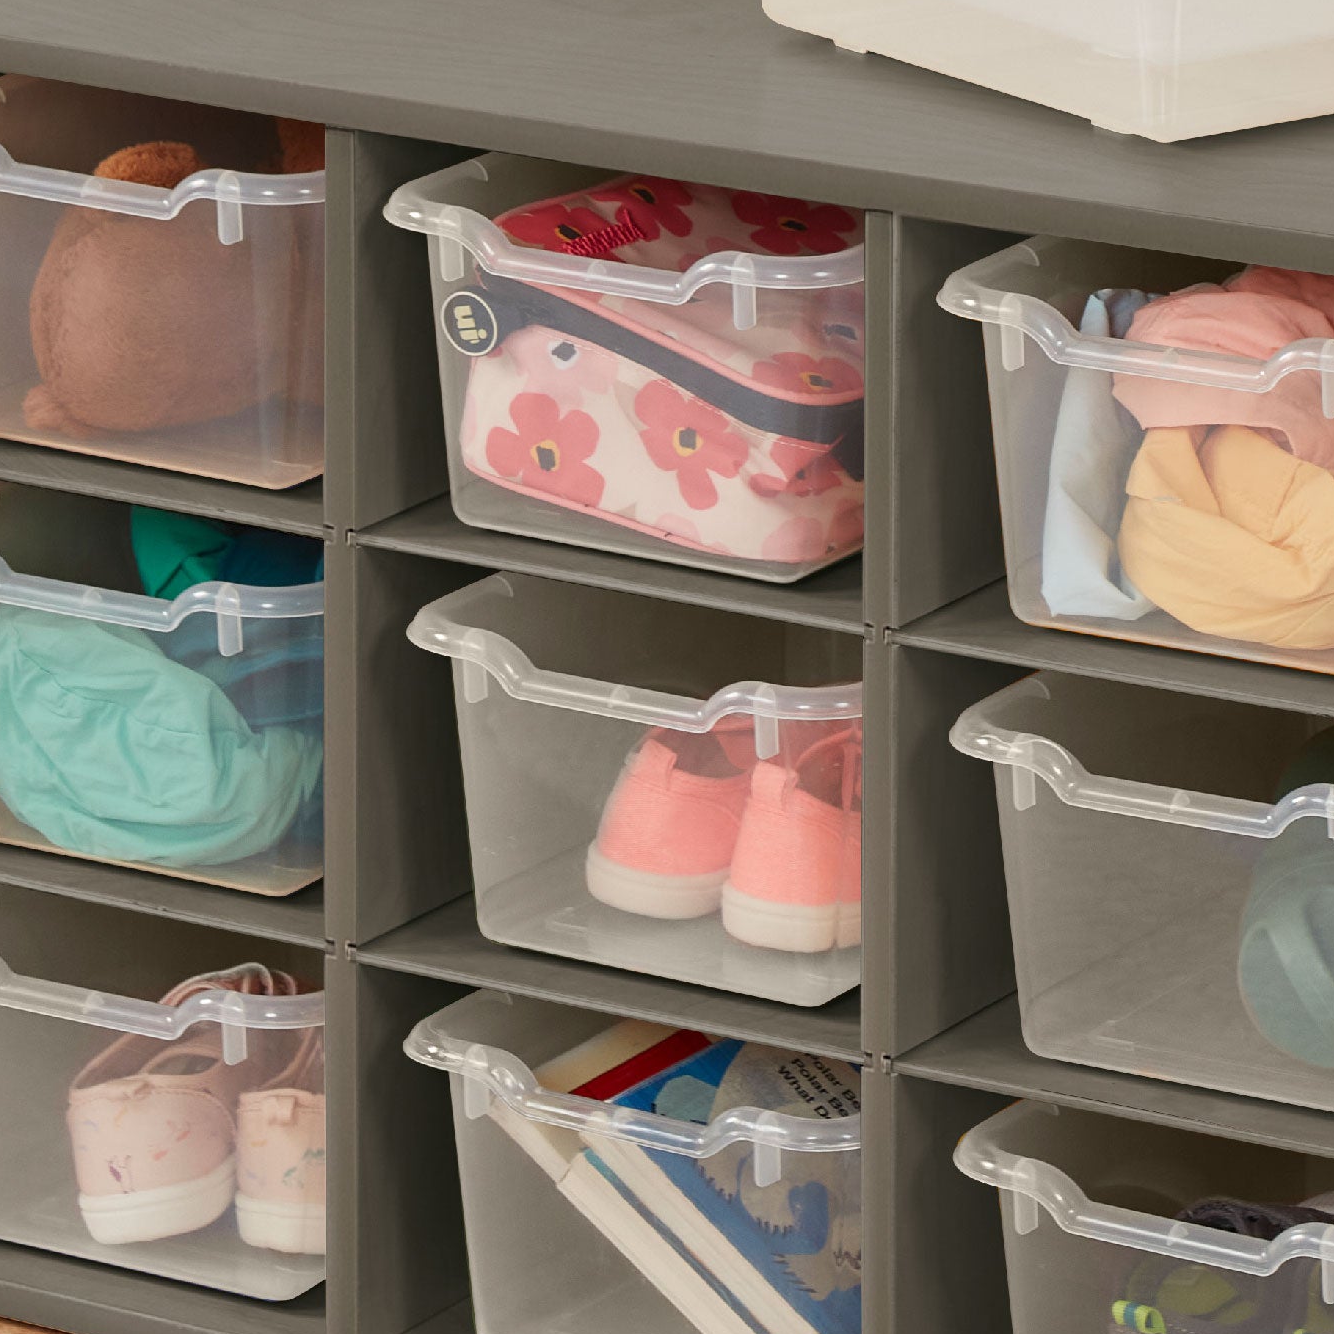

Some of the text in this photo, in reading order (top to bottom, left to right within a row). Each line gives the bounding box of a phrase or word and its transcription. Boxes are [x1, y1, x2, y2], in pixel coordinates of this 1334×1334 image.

[777, 1065, 832, 1120] What D
[790, 1058, 830, 1095] Polar
